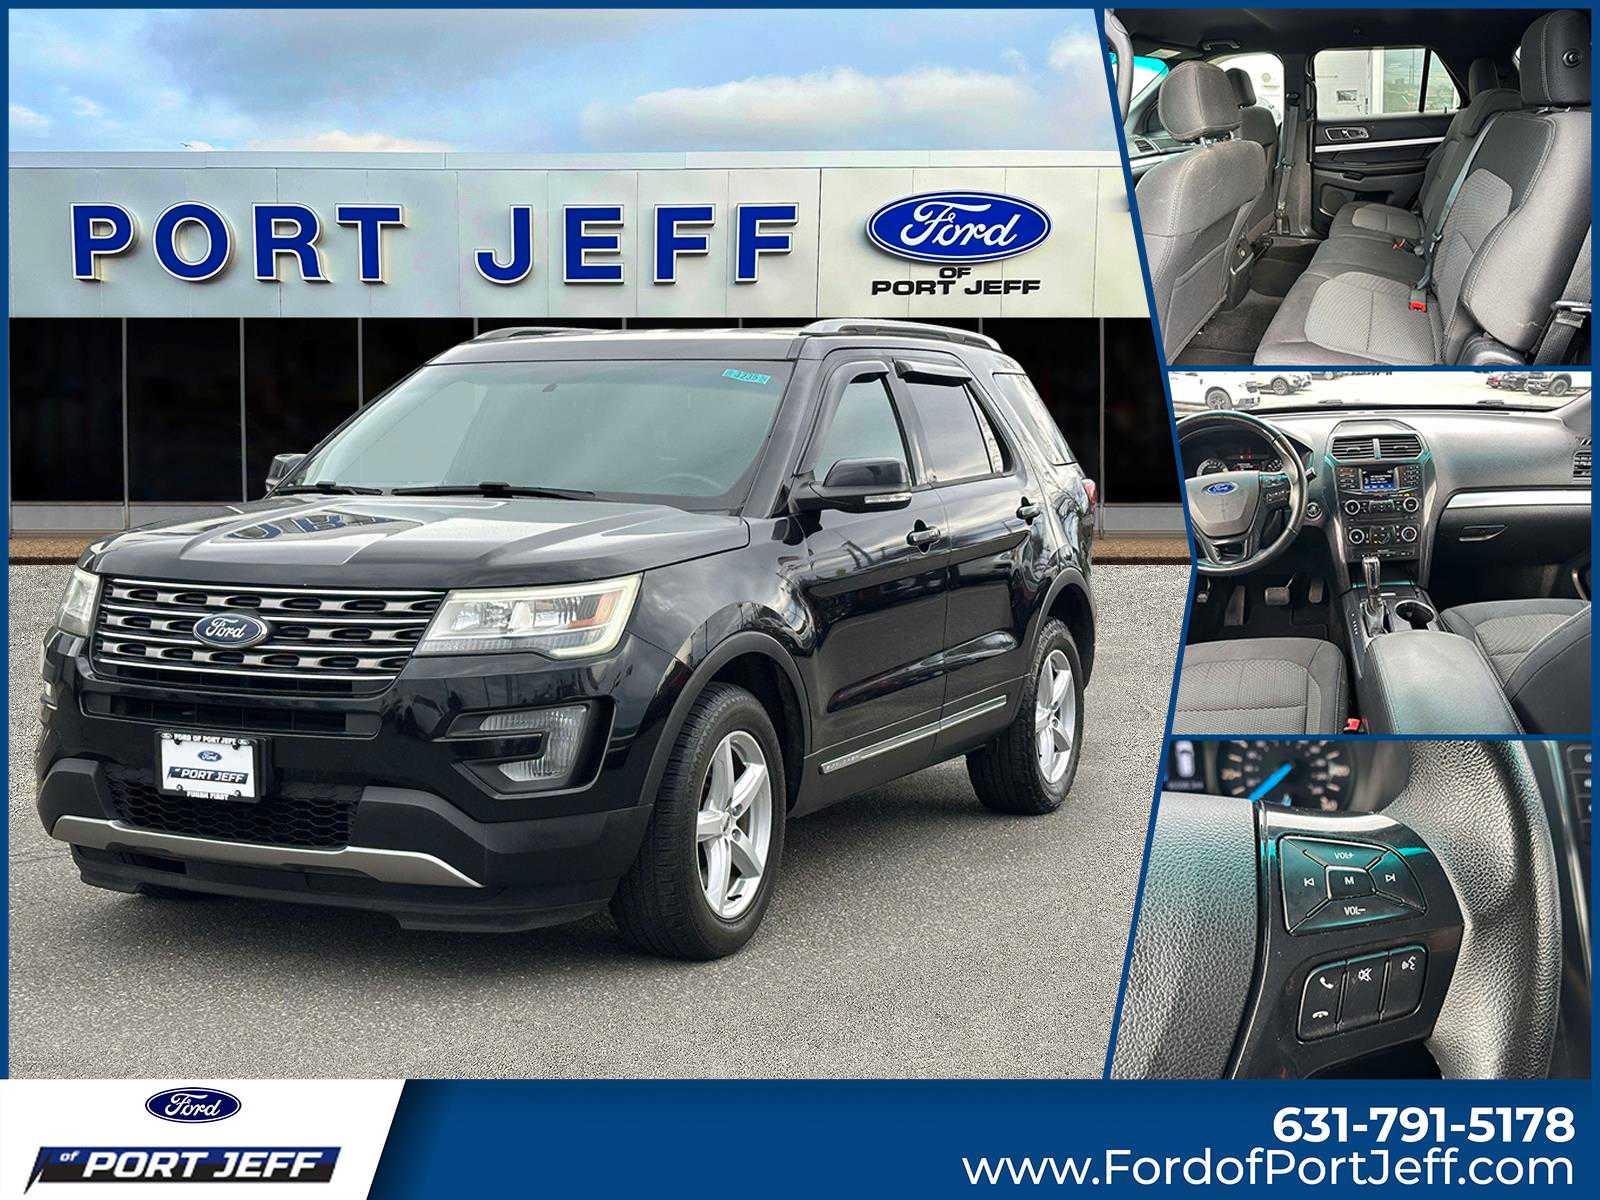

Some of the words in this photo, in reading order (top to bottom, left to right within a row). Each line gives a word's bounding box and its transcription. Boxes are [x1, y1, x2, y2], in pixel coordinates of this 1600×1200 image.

[900, 201, 1022, 247] Ford
[69, 201, 406, 284] PORT
[474, 201, 799, 285] JEFF
[938, 266, 972, 279] OF
[871, 280, 956, 296] PORT
[963, 279, 1041, 295] JEFF
[205, 617, 248, 638] Ford
[180, 768, 213, 780] PORT
[215, 771, 245, 783] JEFF
[1344, 876, 1355, 885] M
